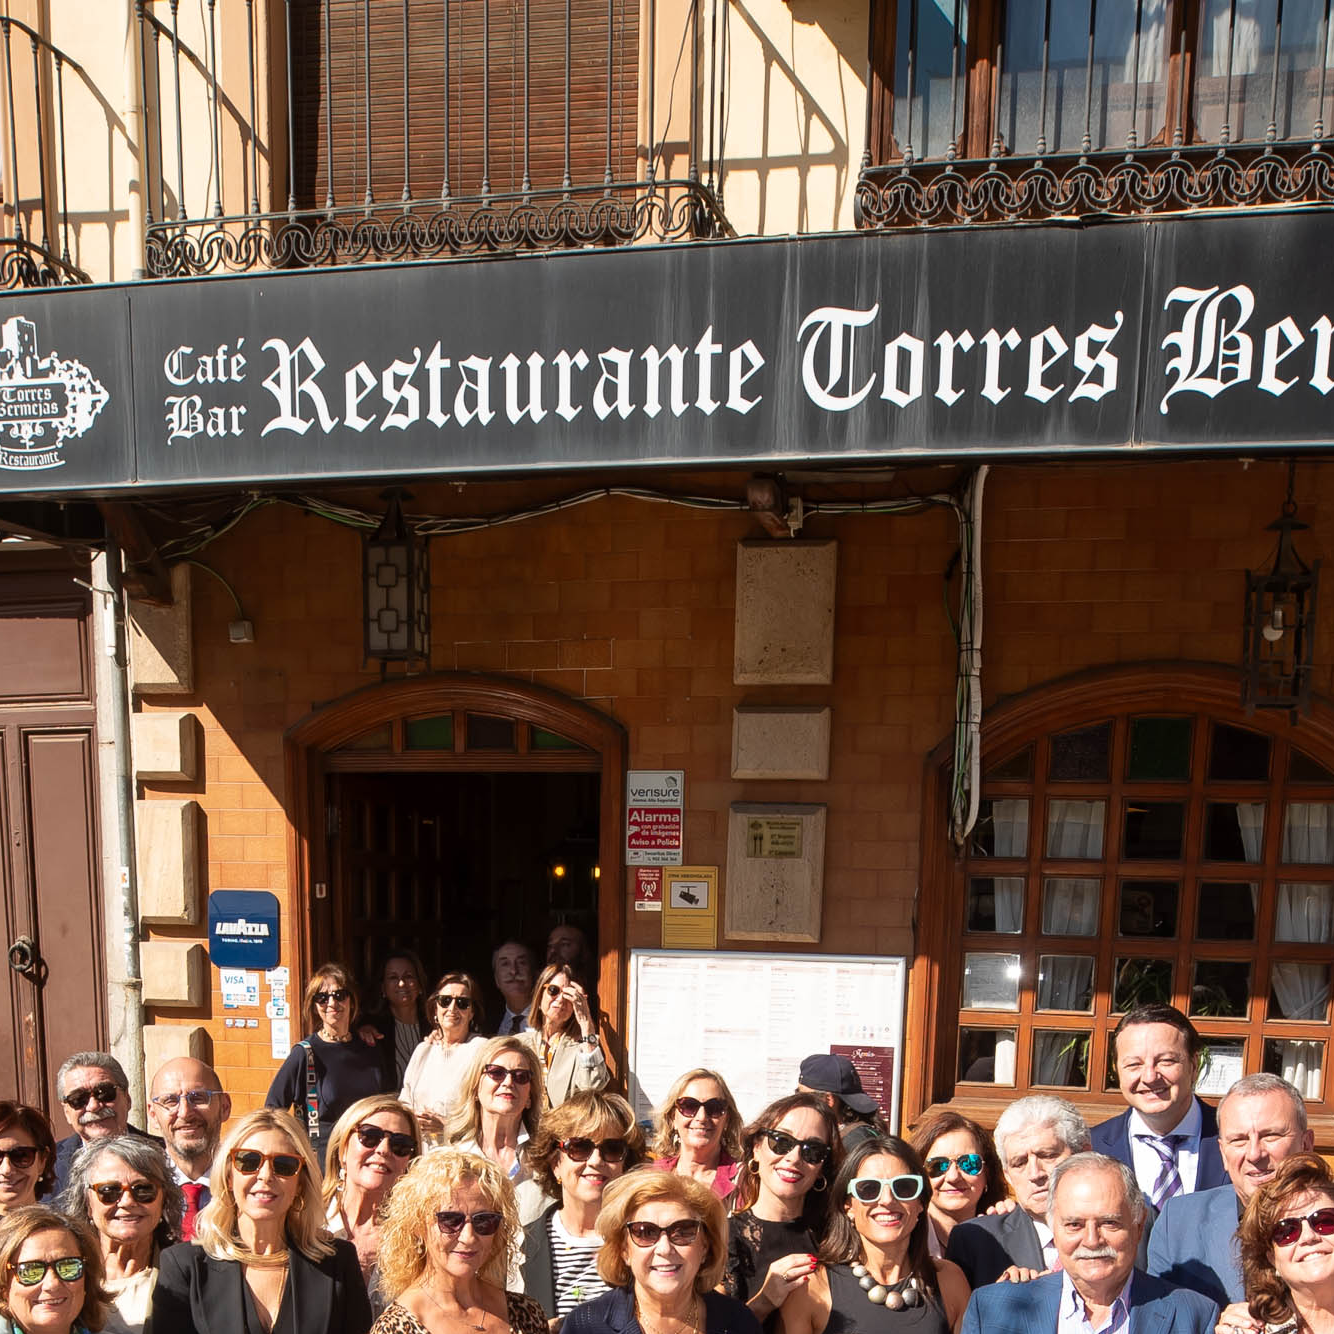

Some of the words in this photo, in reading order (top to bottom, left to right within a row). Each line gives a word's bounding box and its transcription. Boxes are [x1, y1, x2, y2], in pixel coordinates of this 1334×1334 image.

[164, 337, 247, 386] Café
[260, 324, 766, 437] Restaurante
[797, 303, 1124, 411] Torres
[0, 387, 52, 402] Torres
[165, 395, 247, 445] Bar
[630, 788, 680, 797] verisure
[630, 811, 680, 822] Alarma
[224, 976, 244, 984] VISA
